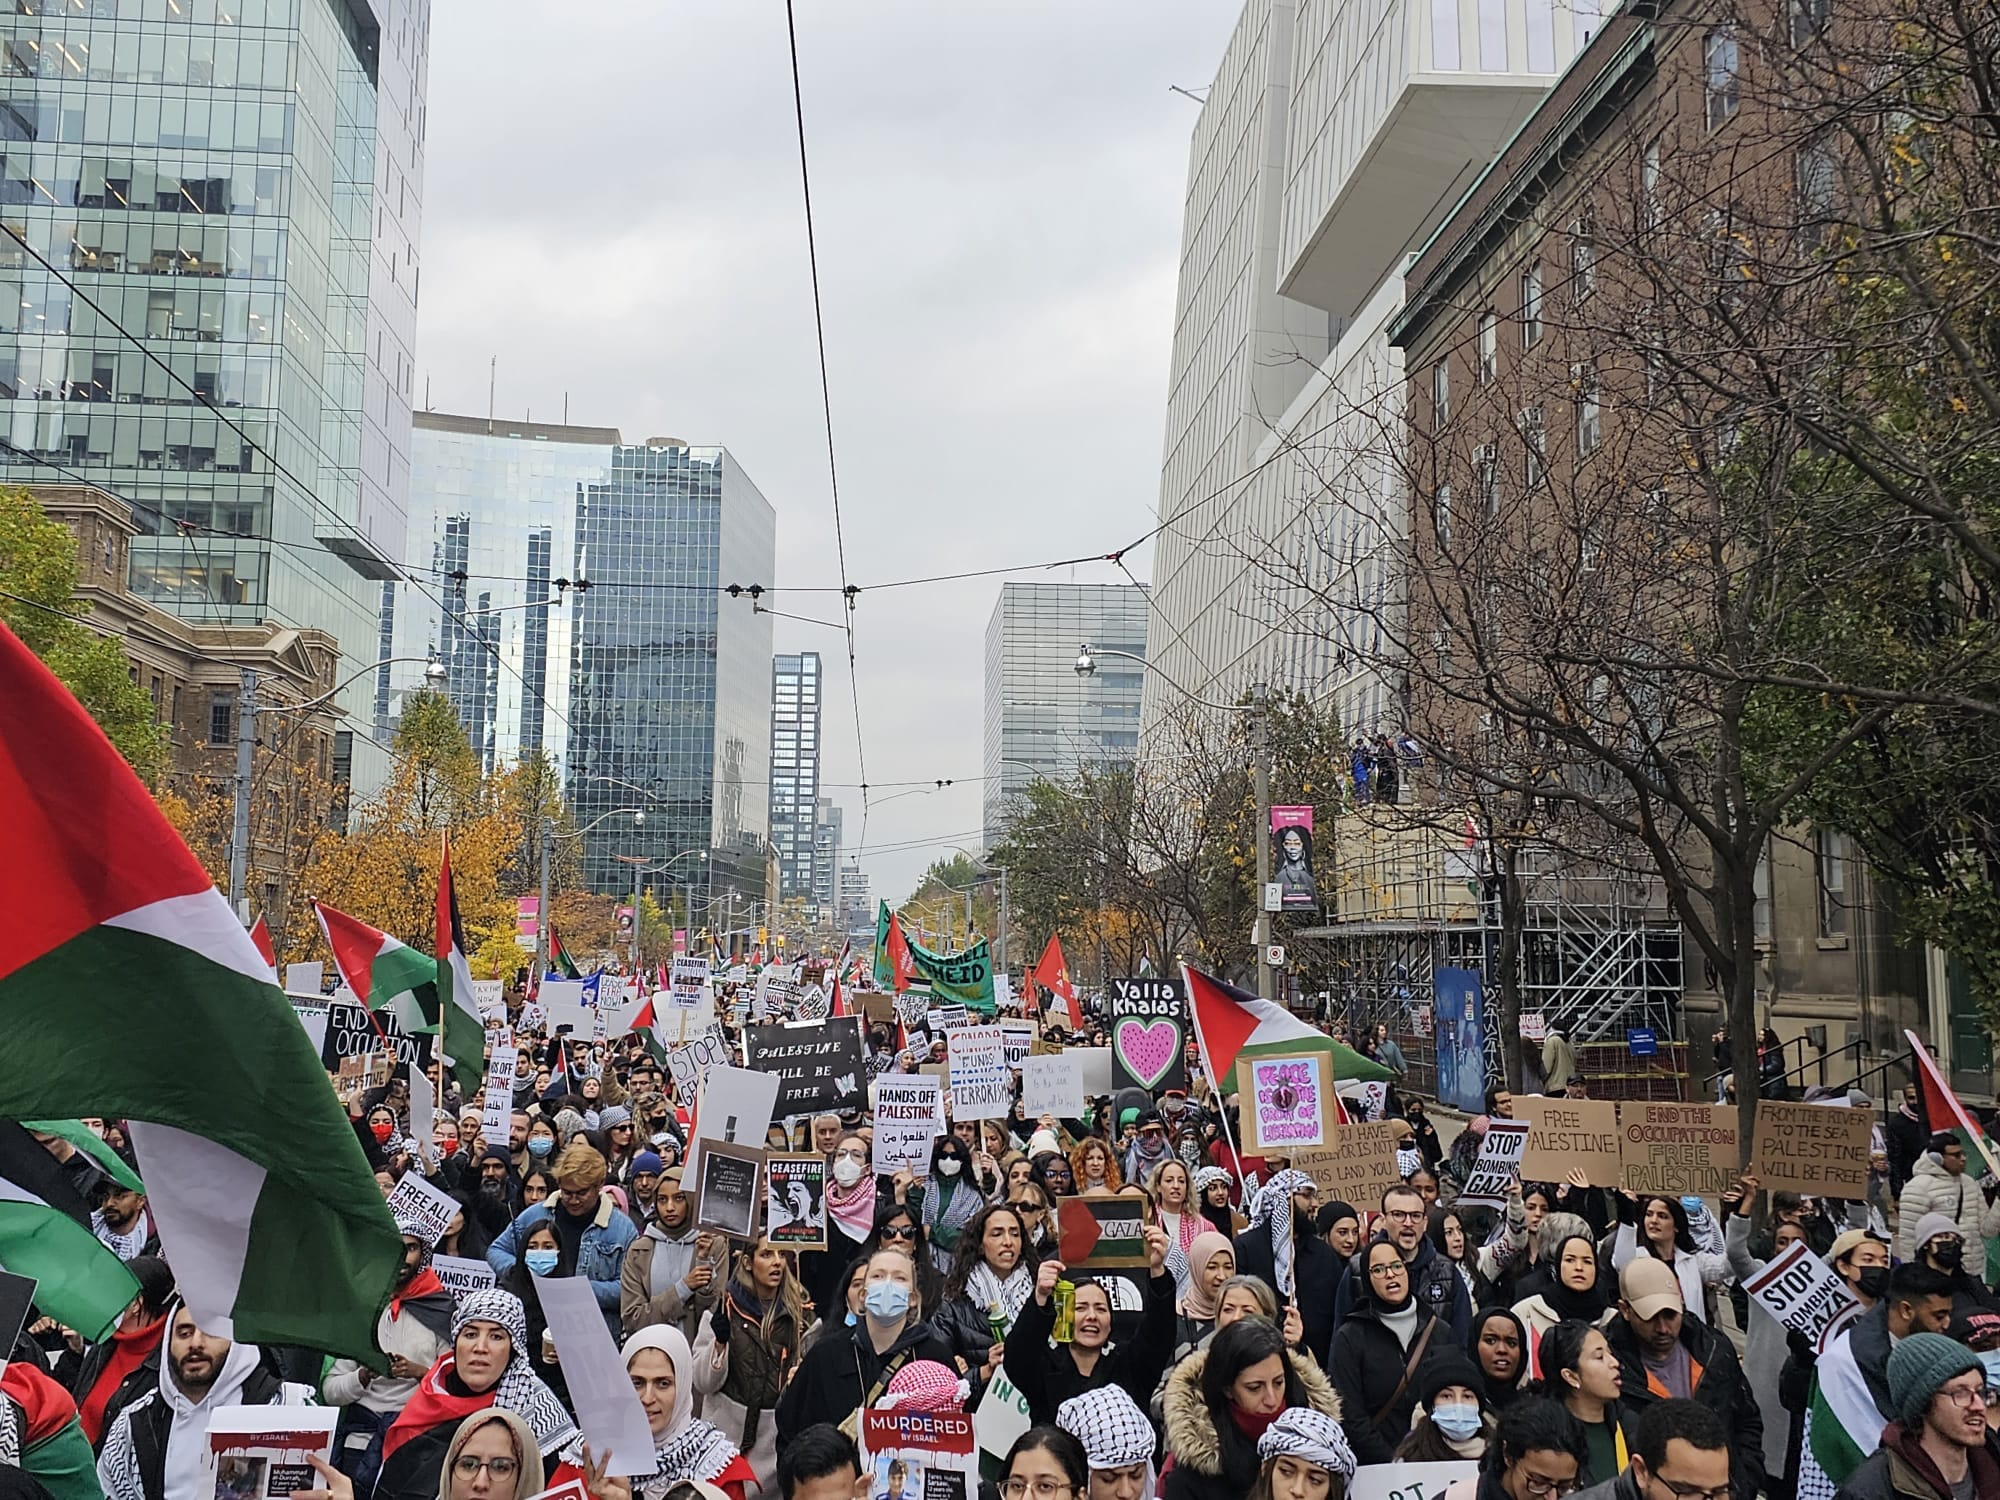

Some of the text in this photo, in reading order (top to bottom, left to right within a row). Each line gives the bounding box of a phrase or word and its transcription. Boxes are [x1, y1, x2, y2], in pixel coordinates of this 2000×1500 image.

[676, 958, 707, 969] CEASEFIRE
[678, 985, 699, 993] STOP
[1115, 980, 1175, 999] Yalla
[332, 1006, 369, 1030] END
[756, 1041, 842, 1059] PALESTINE
[1002, 1038, 1030, 1047] CEASEFIRE
[672, 1035, 717, 1081] STOP
[1003, 1047, 1030, 1064] NOW
[500, 1063, 513, 1075] OFF
[814, 1065, 832, 1078] BE
[1257, 1062, 1312, 1086] PEACE
[786, 1086, 821, 1101] FREE
[879, 1088, 937, 1104] HANDS OFF
[951, 1083, 1008, 1106] TERRORISM
[1258, 1084, 1317, 1104] IS THE
[878, 1104, 935, 1120] PALESTINE
[1297, 1104, 1317, 1119] OF
[1543, 1109, 1581, 1129] FREE
[1646, 1106, 1712, 1125] END THE
[1760, 1104, 1868, 1127] FROM THE RIVER
[881, 1130, 929, 1147] اطلعوا من
[1262, 1120, 1319, 1143] LIBERATION
[1356, 1124, 1390, 1141] HAVE
[1627, 1123, 1736, 1145] OCCUPATION
[1773, 1124, 1850, 1140] TO THE SEA
[1356, 1140, 1372, 1158] IS
[1373, 1139, 1394, 1156] NOT
[1485, 1132, 1523, 1156] STOP
[1761, 1137, 1866, 1162] PALESTINE
[885, 1147, 923, 1162] فلسطين
[1647, 1144, 1710, 1166] FREE
[771, 1162, 823, 1174] CEASEFIRE
[1336, 1165, 1366, 1181] LAND
[1369, 1160, 1393, 1176] YOU
[1474, 1158, 1520, 1176] BOMBING
[1761, 1160, 1863, 1184] WILL BE FREE
[788, 1173, 806, 1181] NOW!
[1466, 1173, 1513, 1196] GAZA
[1625, 1163, 1741, 1194] PALESTINE
[396, 1181, 452, 1224] FREE ALL
[1344, 1184, 1366, 1202] DIE
[389, 1193, 446, 1232] PALESTINIAN
[1104, 1221, 1144, 1239] GAZA
[435, 1269, 492, 1290] HANDS OFF
[1762, 1259, 1816, 1312] STOP
[1781, 1274, 1841, 1332] BOMBING
[1802, 1290, 1851, 1346] GAZA
[992, 1377, 1014, 1403] IN
[869, 1416, 969, 1435] MURDERED
[262, 1433, 291, 1442] ISRAEL
[901, 1433, 939, 1444] BY ISRAEL
